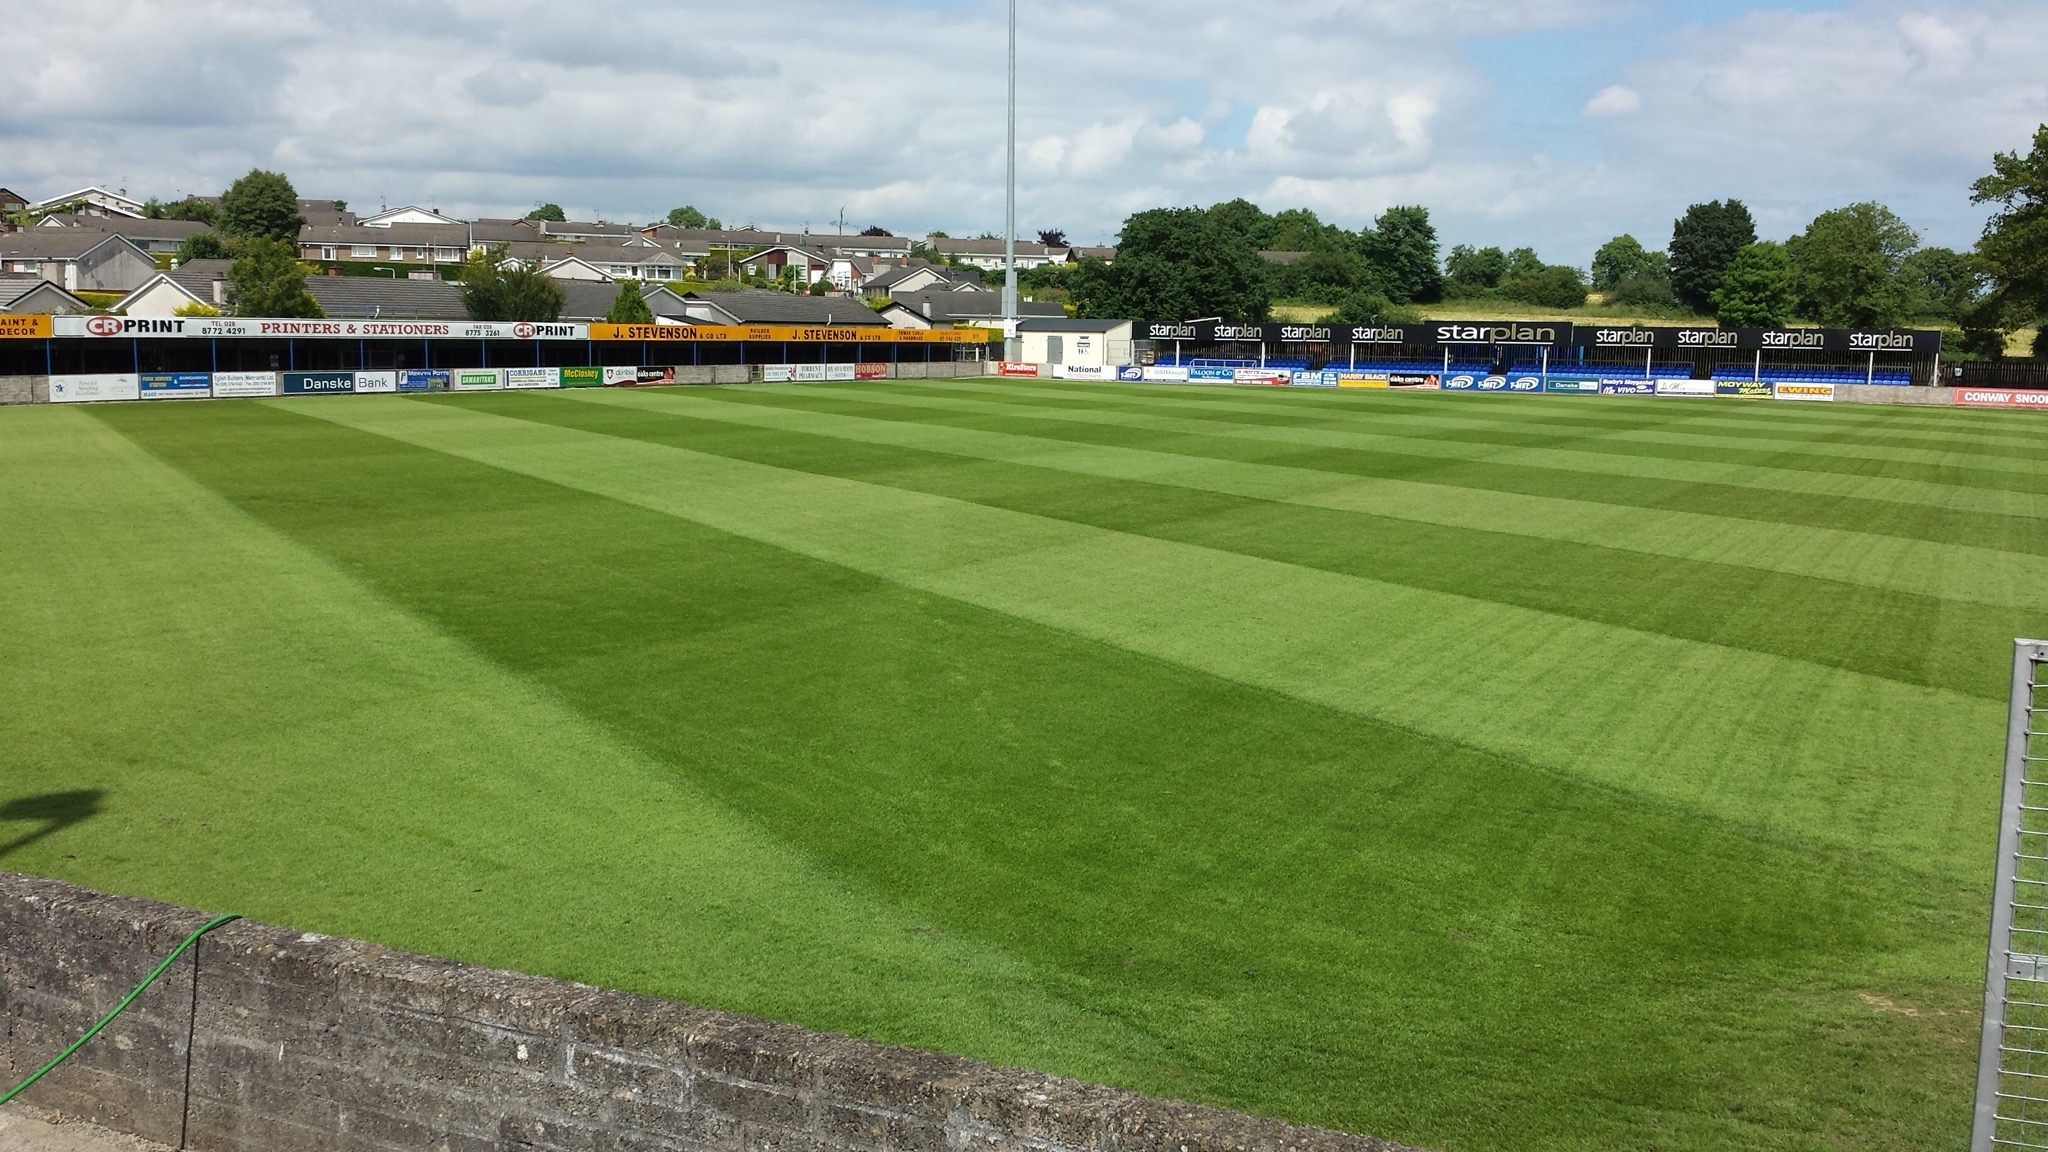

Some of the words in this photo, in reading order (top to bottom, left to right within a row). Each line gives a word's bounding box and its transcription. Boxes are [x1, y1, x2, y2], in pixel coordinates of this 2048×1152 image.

[88, 320, 118, 333] CR
[124, 320, 185, 332] PRINT
[260, 323, 340, 334] PRINTERS
[346, 324, 357, 334] &
[363, 324, 449, 335] STATIONERS
[516, 326, 534, 336] CR
[537, 326, 575, 336] PRINT
[613, 327, 624, 339] J.
[628, 327, 697, 339] STEVENSON
[1150, 322, 1196, 339] starplan
[1214, 323, 1262, 340] starplan
[1281, 324, 1330, 341] starplan
[792, 329, 800, 340] J.
[804, 330, 857, 340] STEVENSON
[1352, 325, 1403, 342] starplan
[1437, 324, 1555, 344] starplan
[1596, 327, 1654, 346] starplan
[1678, 328, 1738, 347] starplan
[1762, 329, 1824, 349] starplan
[1849, 331, 1913, 350] starplan
[564, 370, 598, 379] McCloskey
[856, 364, 886, 373] HOBSON
[303, 378, 351, 389] Danske
[359, 377, 387, 388] Bank
[1964, 392, 2012, 402] CONWAY
